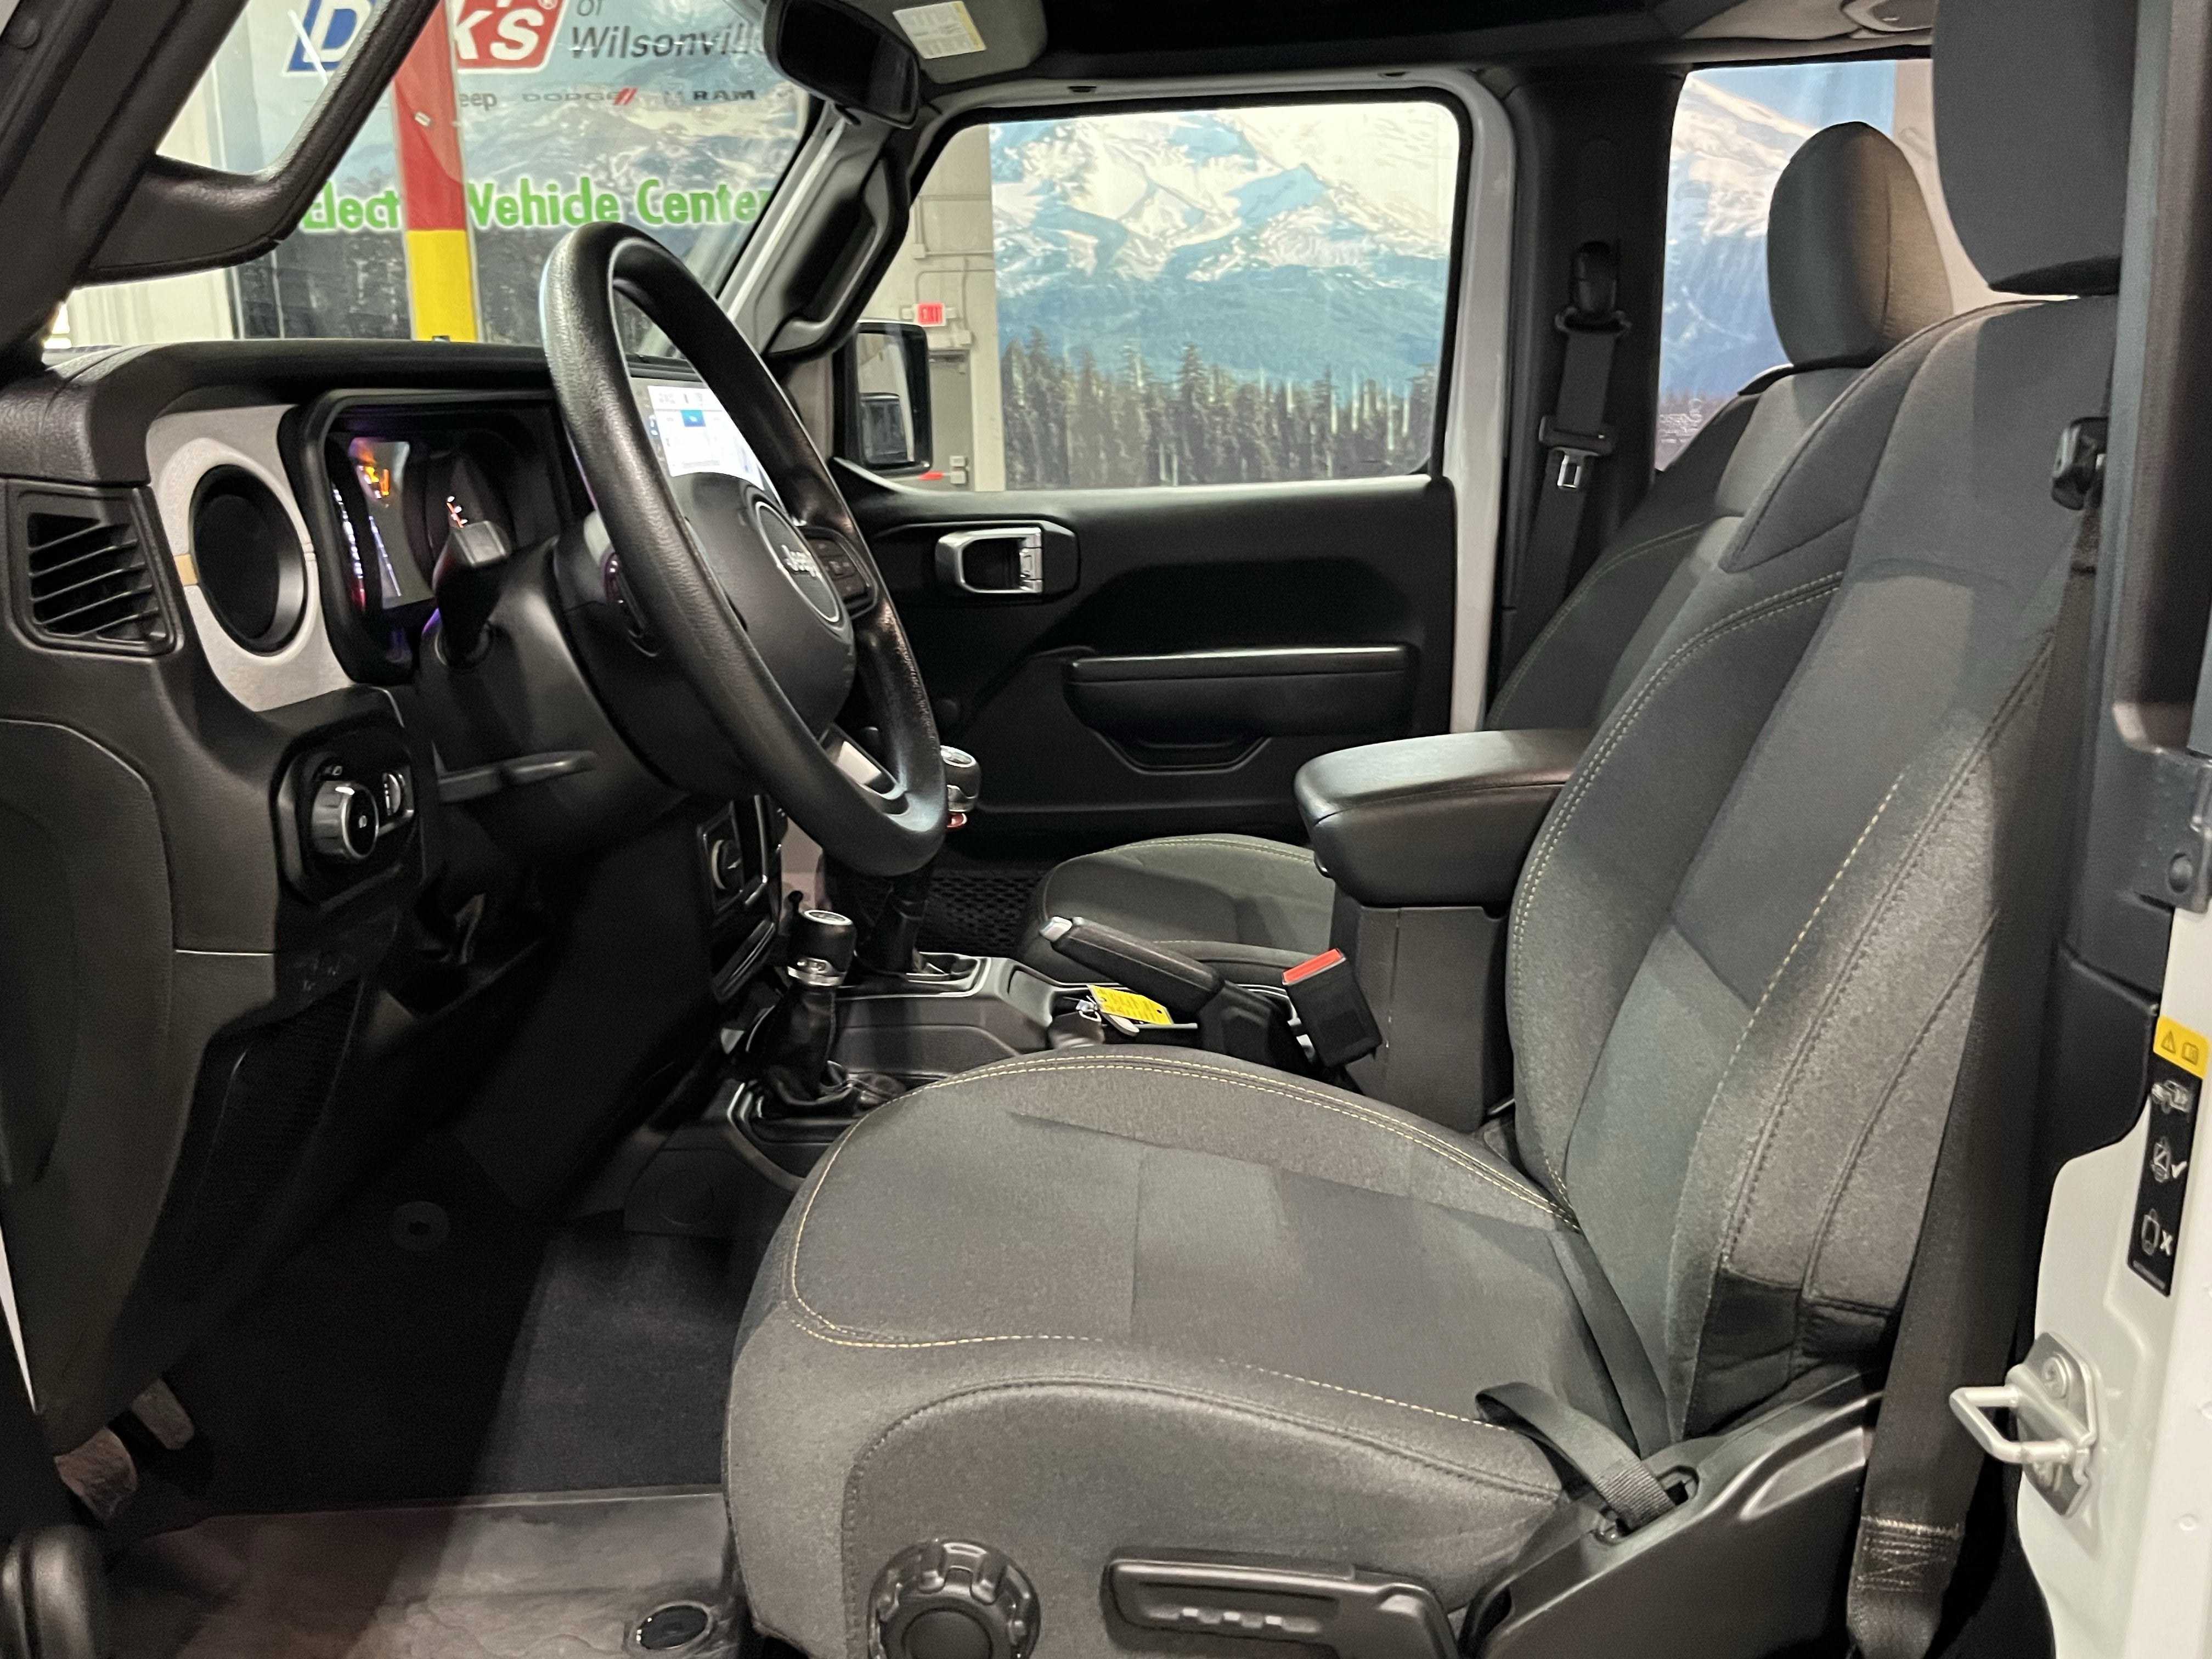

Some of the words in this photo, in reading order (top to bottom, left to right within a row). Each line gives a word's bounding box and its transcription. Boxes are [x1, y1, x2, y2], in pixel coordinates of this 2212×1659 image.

[572, 23, 763, 59] Wilsonvill
[459, 93, 497, 111] eep
[692, 89, 755, 101] RAM
[466, 176, 620, 227] Vehicle
[920, 306, 942, 322] EXIT
